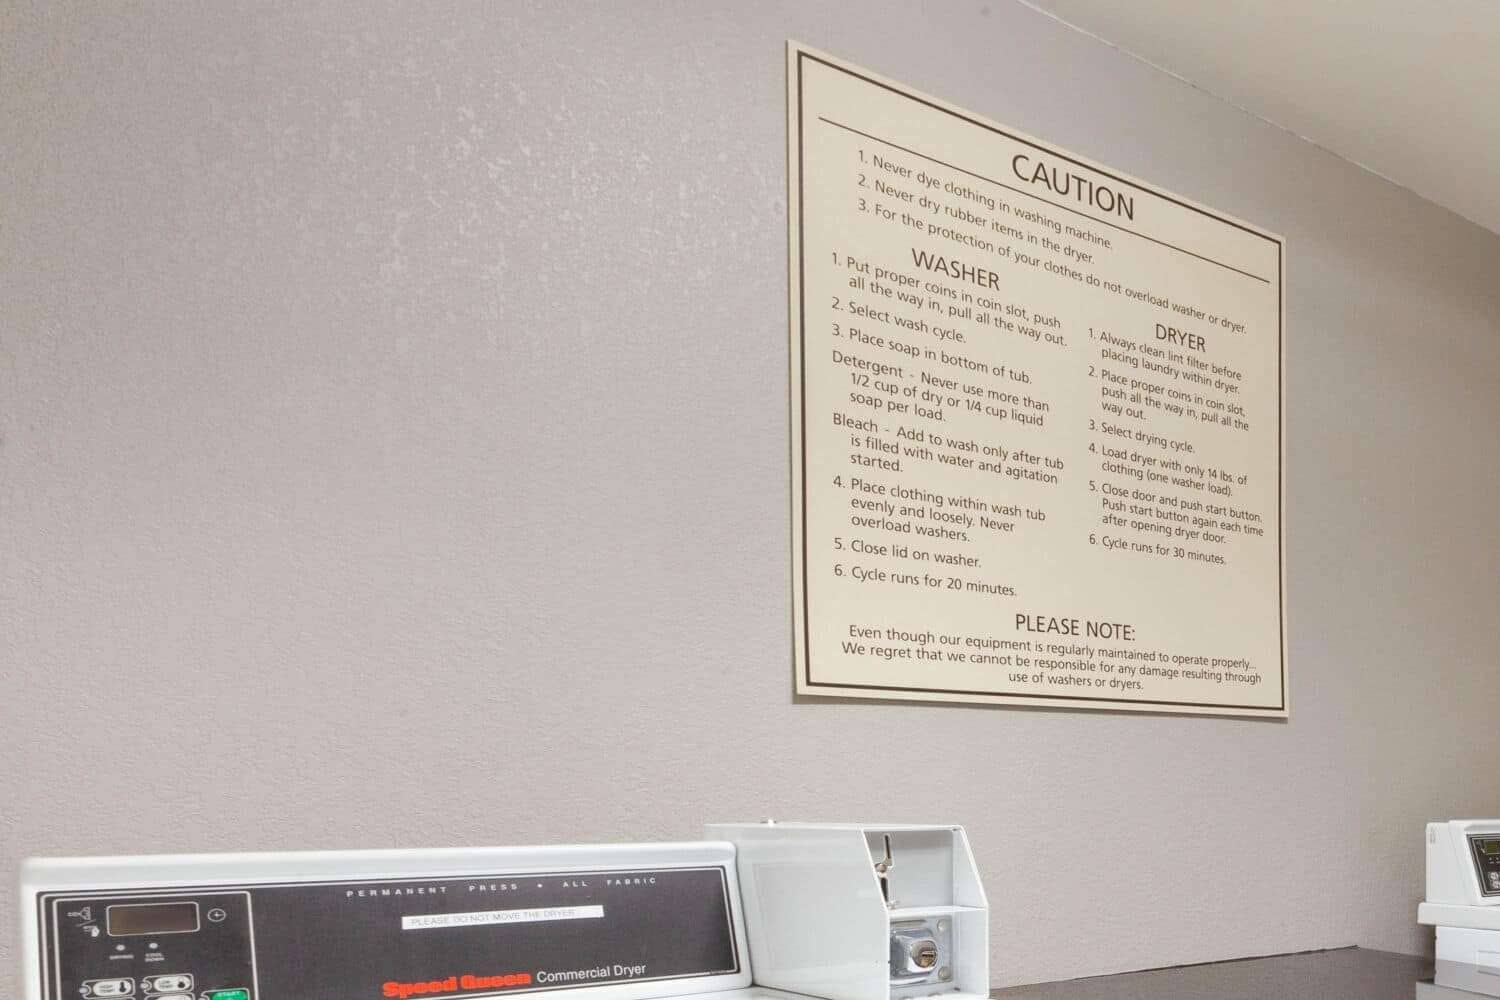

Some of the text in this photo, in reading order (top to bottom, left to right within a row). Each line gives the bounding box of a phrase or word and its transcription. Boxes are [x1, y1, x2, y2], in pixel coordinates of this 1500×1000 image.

[858, 149, 1113, 250] 1. Never dye clothing in washing machine.
[1012, 154, 1134, 221] CAUTION
[858, 173, 1095, 265] 2. Never dry rubber items in the dryer.
[858, 198, 1247, 334] 3. For the protection of your clothes do not overload washer or dryer.
[911, 247, 1000, 291] WASHER
[831, 296, 966, 344] 2. Select wash cycle.
[1155, 323, 1206, 353] DRYER
[832, 323, 1032, 385] 3. Place soap in bottom of tub.
[1088, 418, 1195, 454] 3. Select drying cycle.
[851, 453, 903, 473] started.
[834, 537, 981, 568] 5. Close lid on washer.
[1089, 533, 1226, 565] 6. Cycle runs for 30 minutes.
[849, 624, 882, 639] Even
[885, 627, 935, 646] though
[939, 635, 961, 646] our
[965, 637, 1032, 652] equipment
[1035, 640, 1044, 653] is
[1046, 643, 1095, 659] regularly
[1098, 648, 1156, 662] maintained
[1158, 652, 1170, 663] to
[1171, 655, 1209, 666] operate
[1016, 613, 1135, 641] PLEASE NOTE:
[841, 641, 1262, 685] We regret that we cannot be responsible for any damage resulting through
[1008, 671, 1144, 691] use of washers or dryers.
[346, 877, 657, 898] PERMANENT PRESS ALL FABRIC
[411, 915, 450, 927] PLEASE
[492, 911, 521, 922] MOVE
[523, 911, 541, 920] THE
[383, 963, 646, 998] Speed Queen Commercial Dryer
